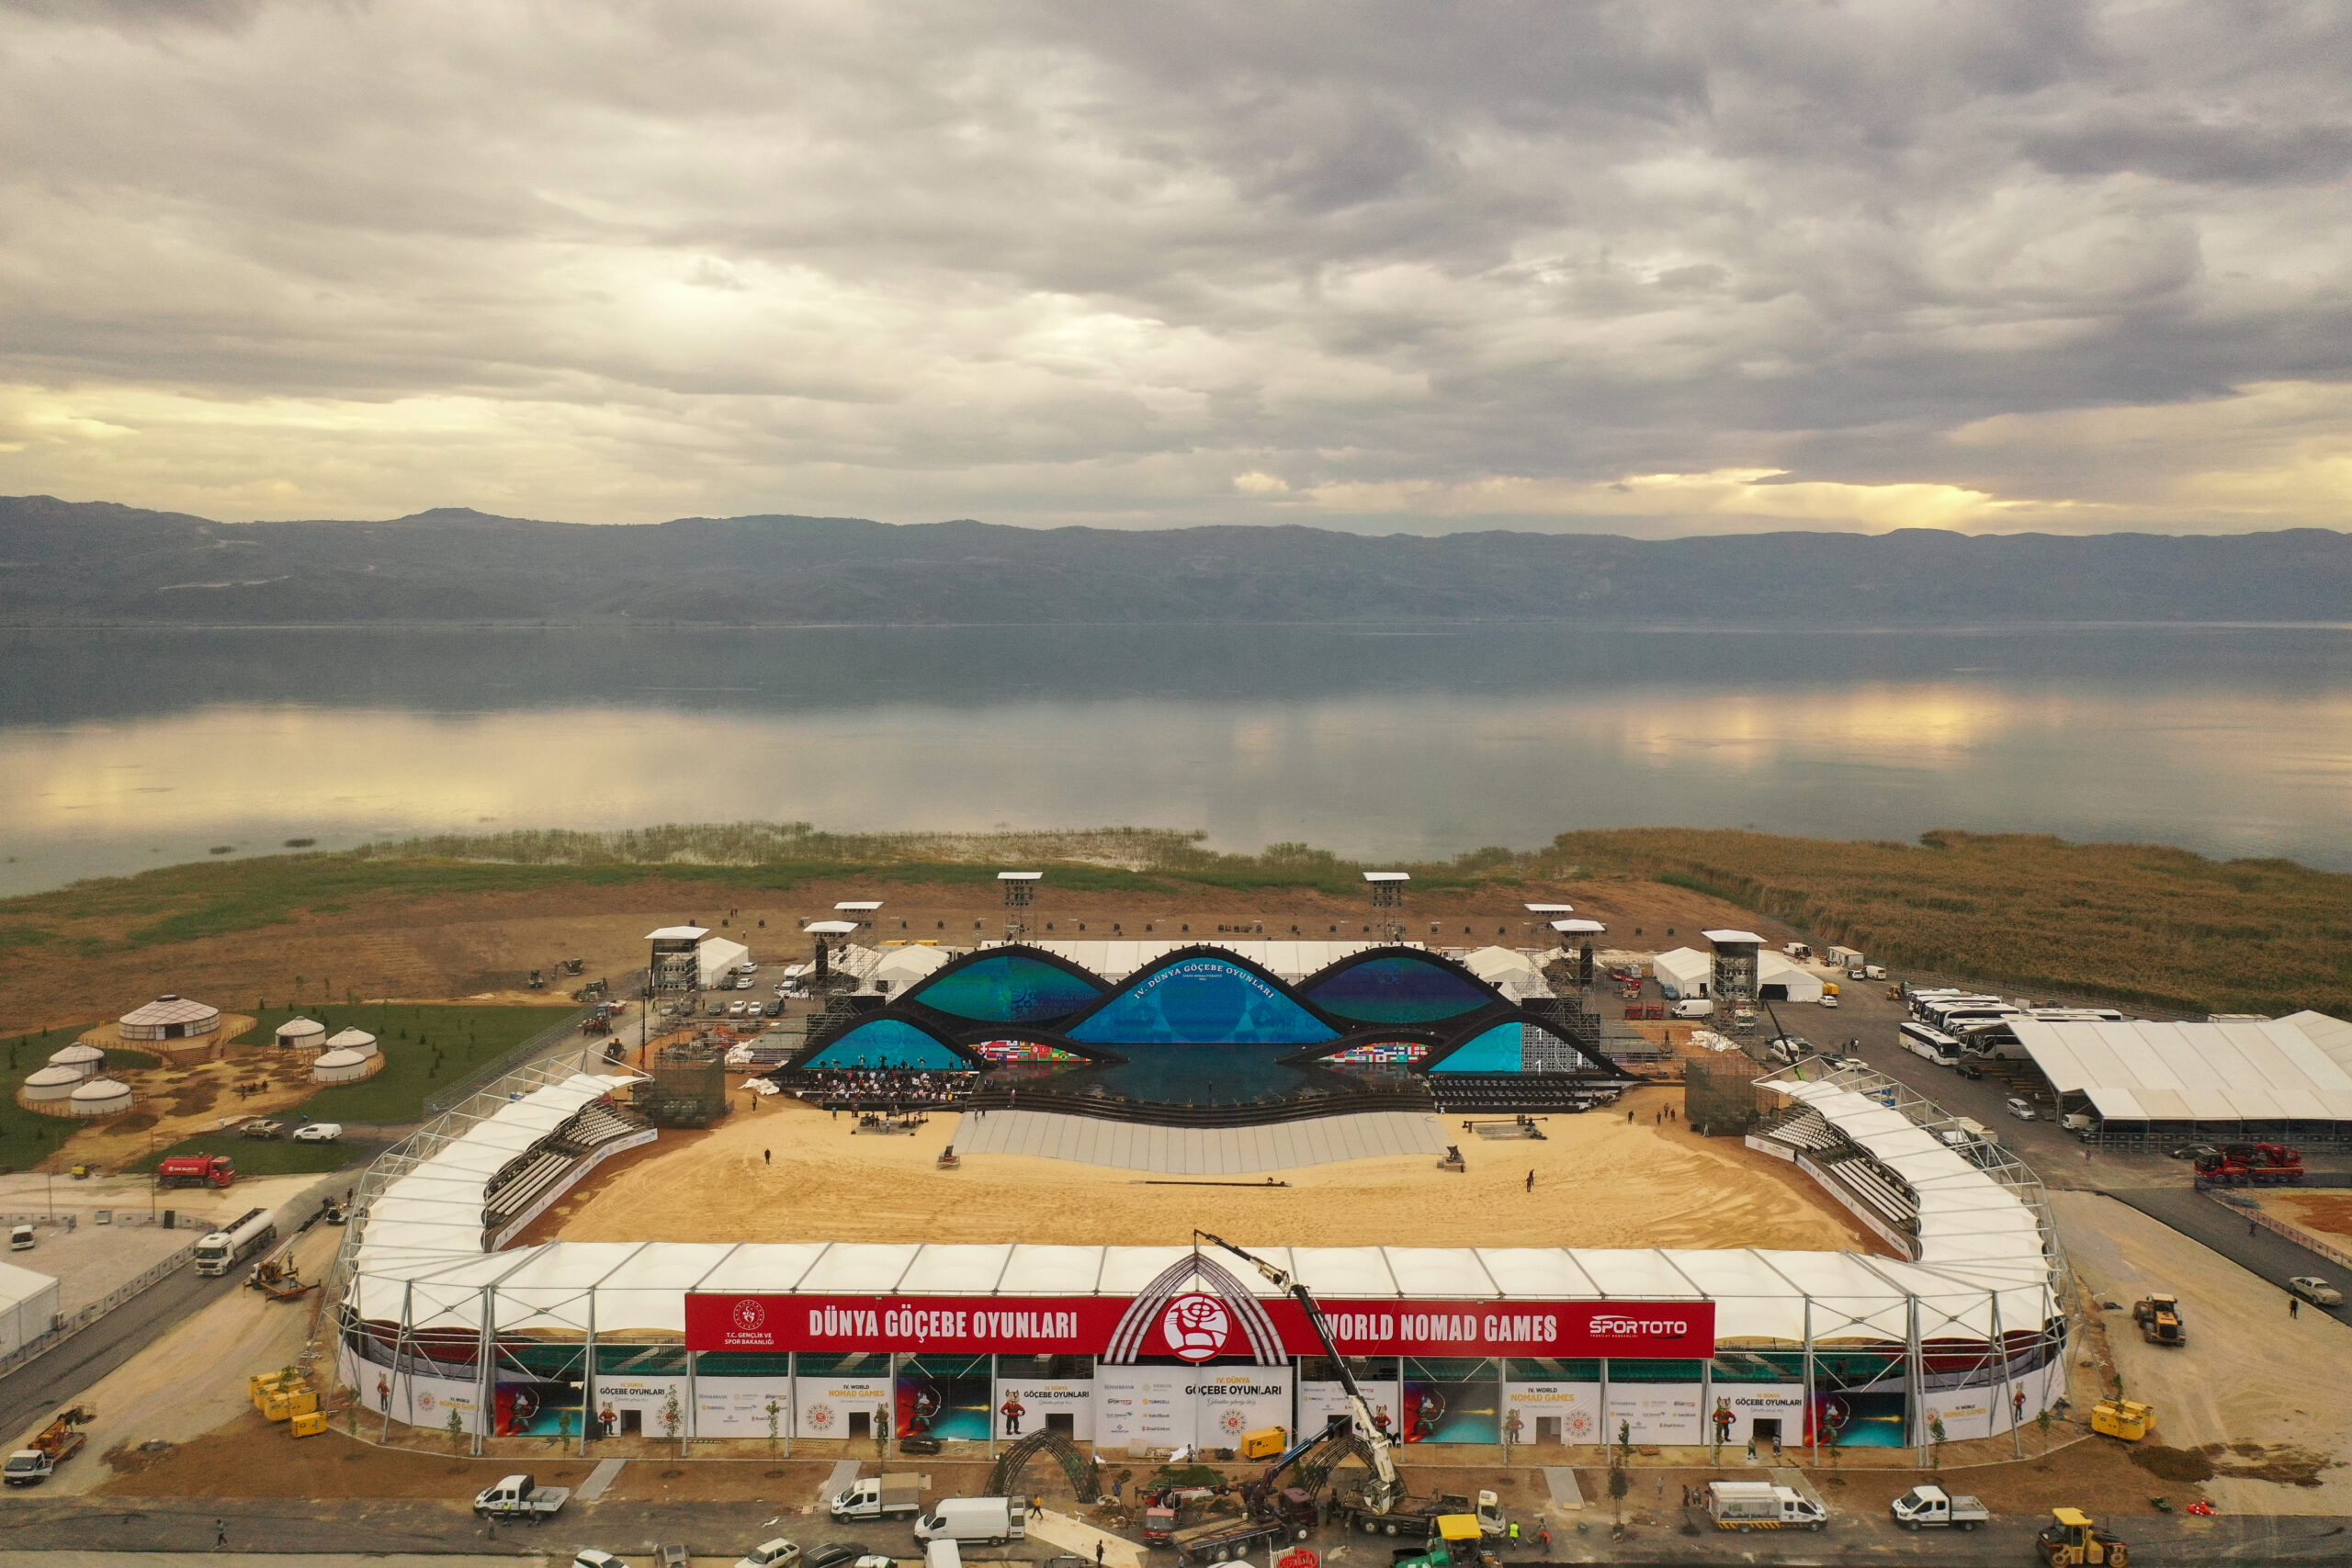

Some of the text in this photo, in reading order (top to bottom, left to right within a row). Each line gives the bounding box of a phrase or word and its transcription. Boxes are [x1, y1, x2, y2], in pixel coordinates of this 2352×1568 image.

[1134, 963, 1275, 1000] IV. DÜNYA GÖÇEBE OYUNLARI
[809, 1304, 1078, 1343] DÜNYA GÖÇEBE OYUNLARI
[1320, 1314, 1557, 1342] WORLD NOMAD GAMES
[1589, 1320, 1688, 1334] SPORTOTO
[738, 1331, 763, 1339] GENÇLİK
[1226, 1375, 1250, 1383] DÜNYA
[600, 1387, 628, 1395] GÖÇEBE
[1023, 1390, 1052, 1399] GÖÇEBE
[1229, 1385, 1282, 1395] OYUNLARI
[1736, 1397, 1764, 1406] GÖÇEBE
